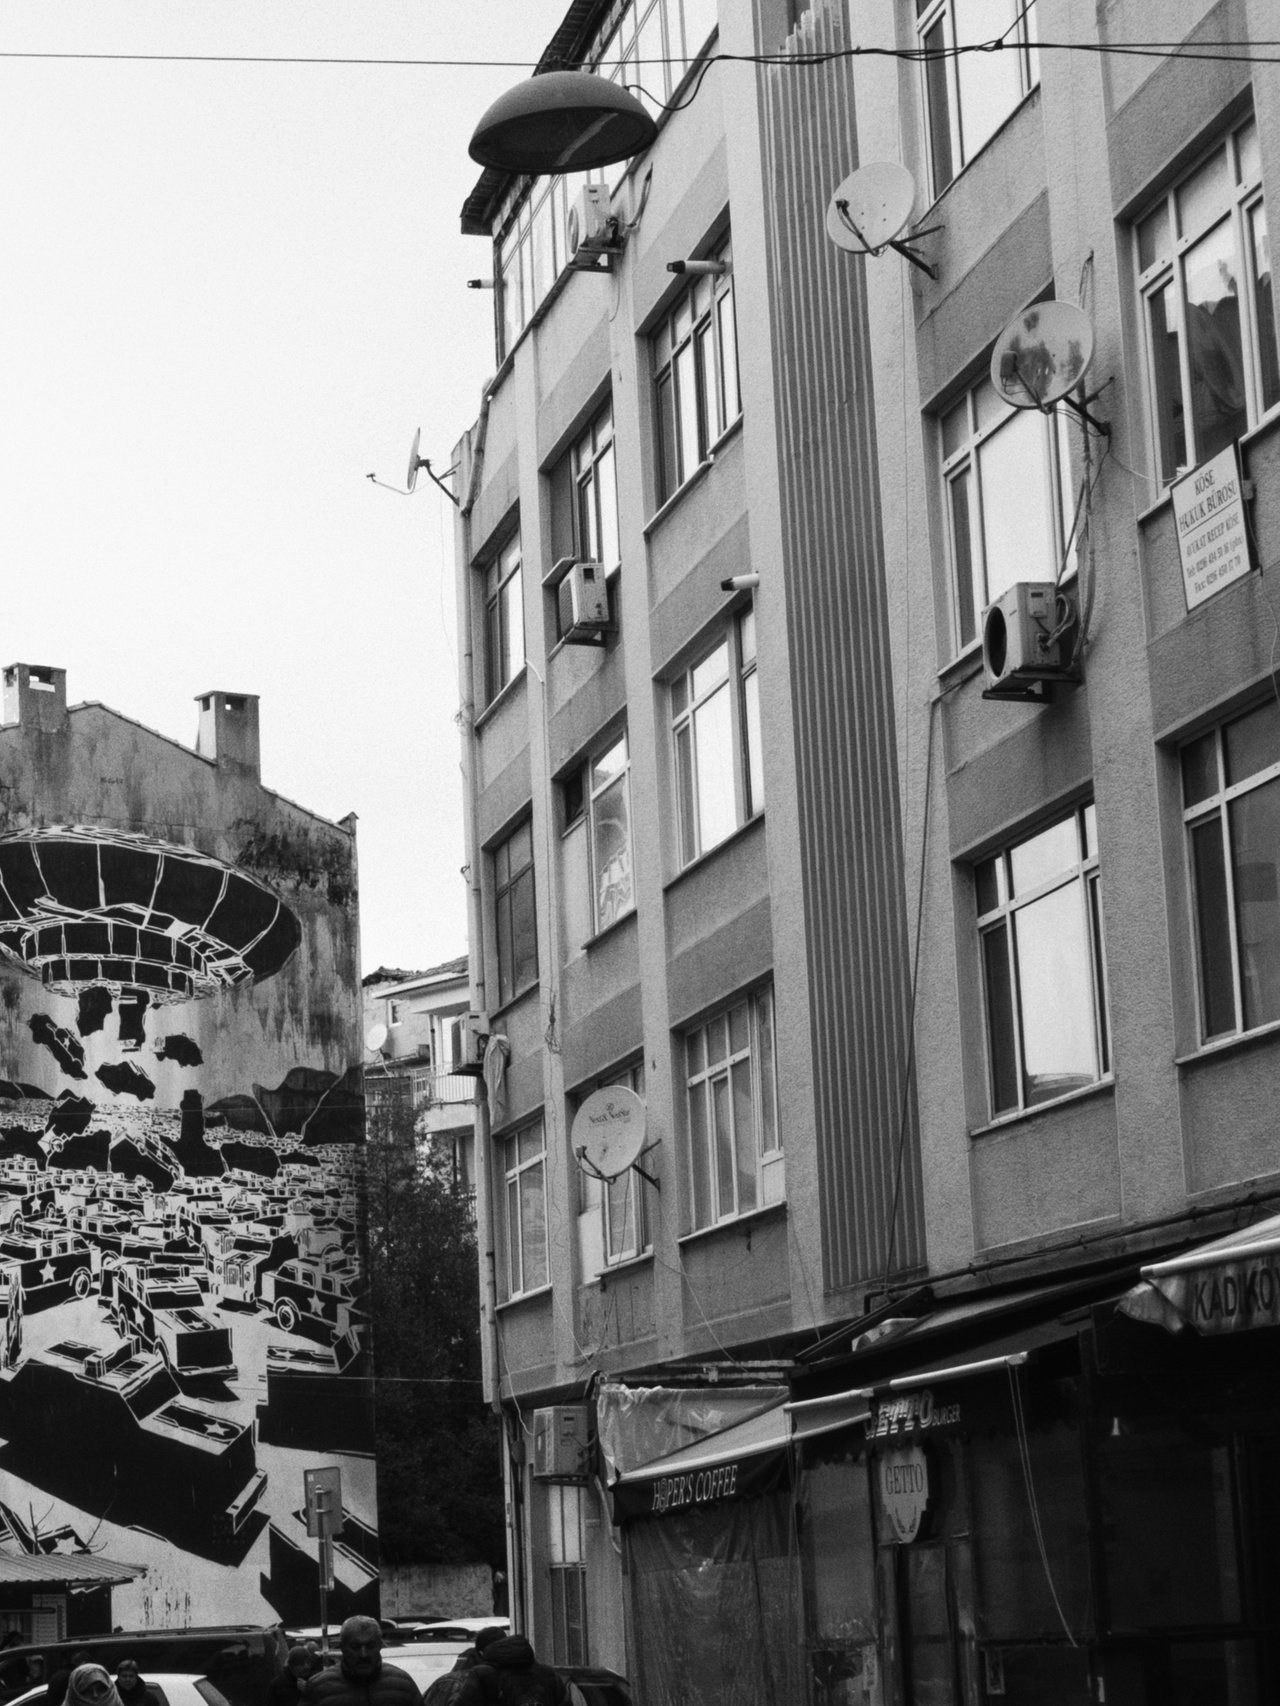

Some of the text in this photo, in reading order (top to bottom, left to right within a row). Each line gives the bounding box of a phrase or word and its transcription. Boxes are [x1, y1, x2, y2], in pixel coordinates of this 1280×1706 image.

[1194, 469, 1216, 496] KÖSE
[1179, 479, 1237, 532] HUKUK BÜROSU
[1207, 522, 1225, 544] RECEP
[1225, 511, 1240, 531] KÖSE
[1194, 1257, 1280, 1321] KADIKÖ
[932, 1403, 961, 1427] BURGER
[695, 1464, 738, 1502] COFFEE
[885, 1463, 924, 1495] GETTO
